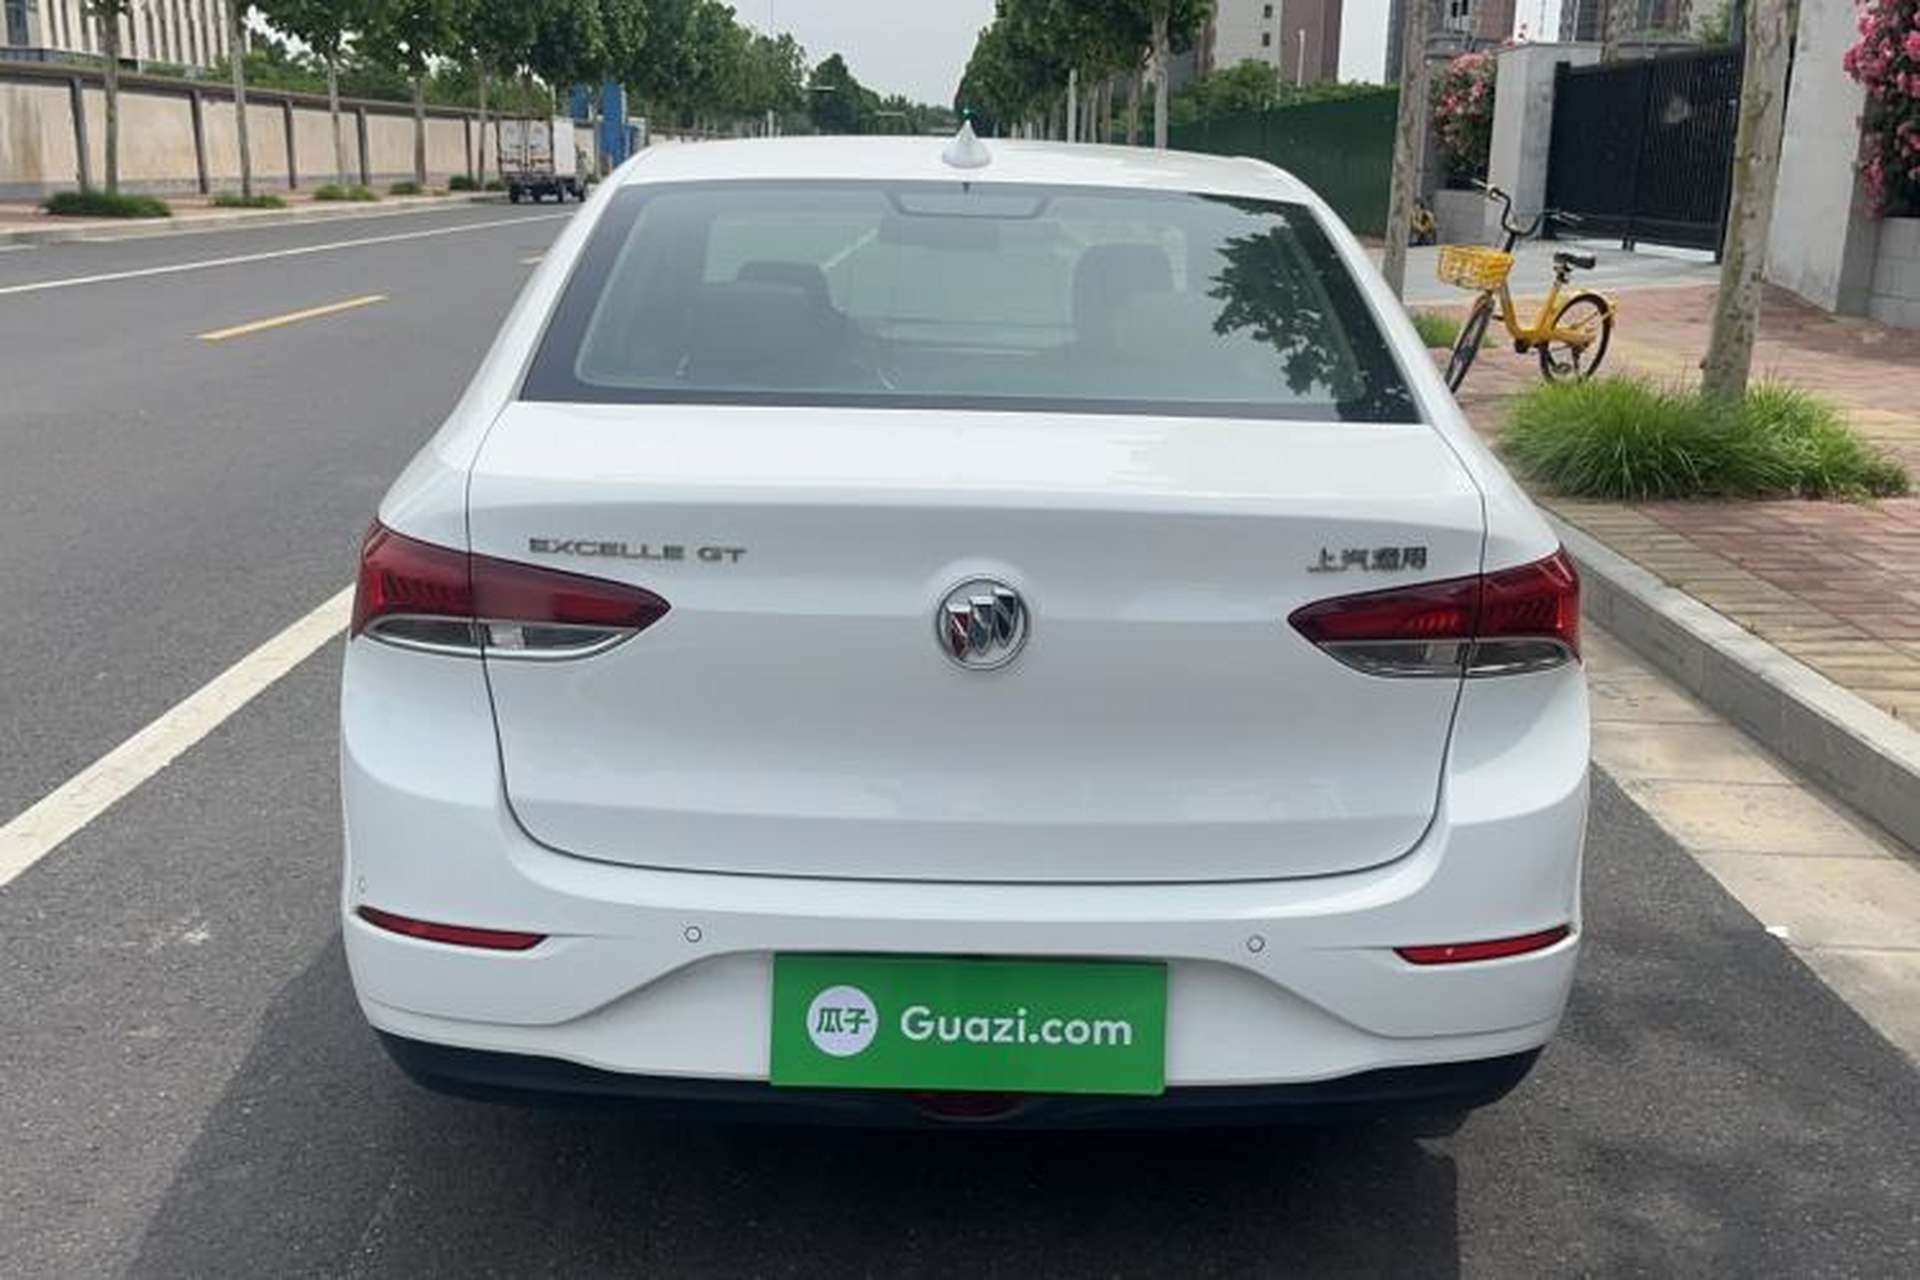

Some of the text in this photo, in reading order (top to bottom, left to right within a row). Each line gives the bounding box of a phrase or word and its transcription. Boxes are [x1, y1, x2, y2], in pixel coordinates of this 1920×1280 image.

[529, 538, 748, 564] EXCELLE GT
[816, 1007, 869, 1035] 瓜子
[900, 1005, 1133, 1046] Guazi.com
